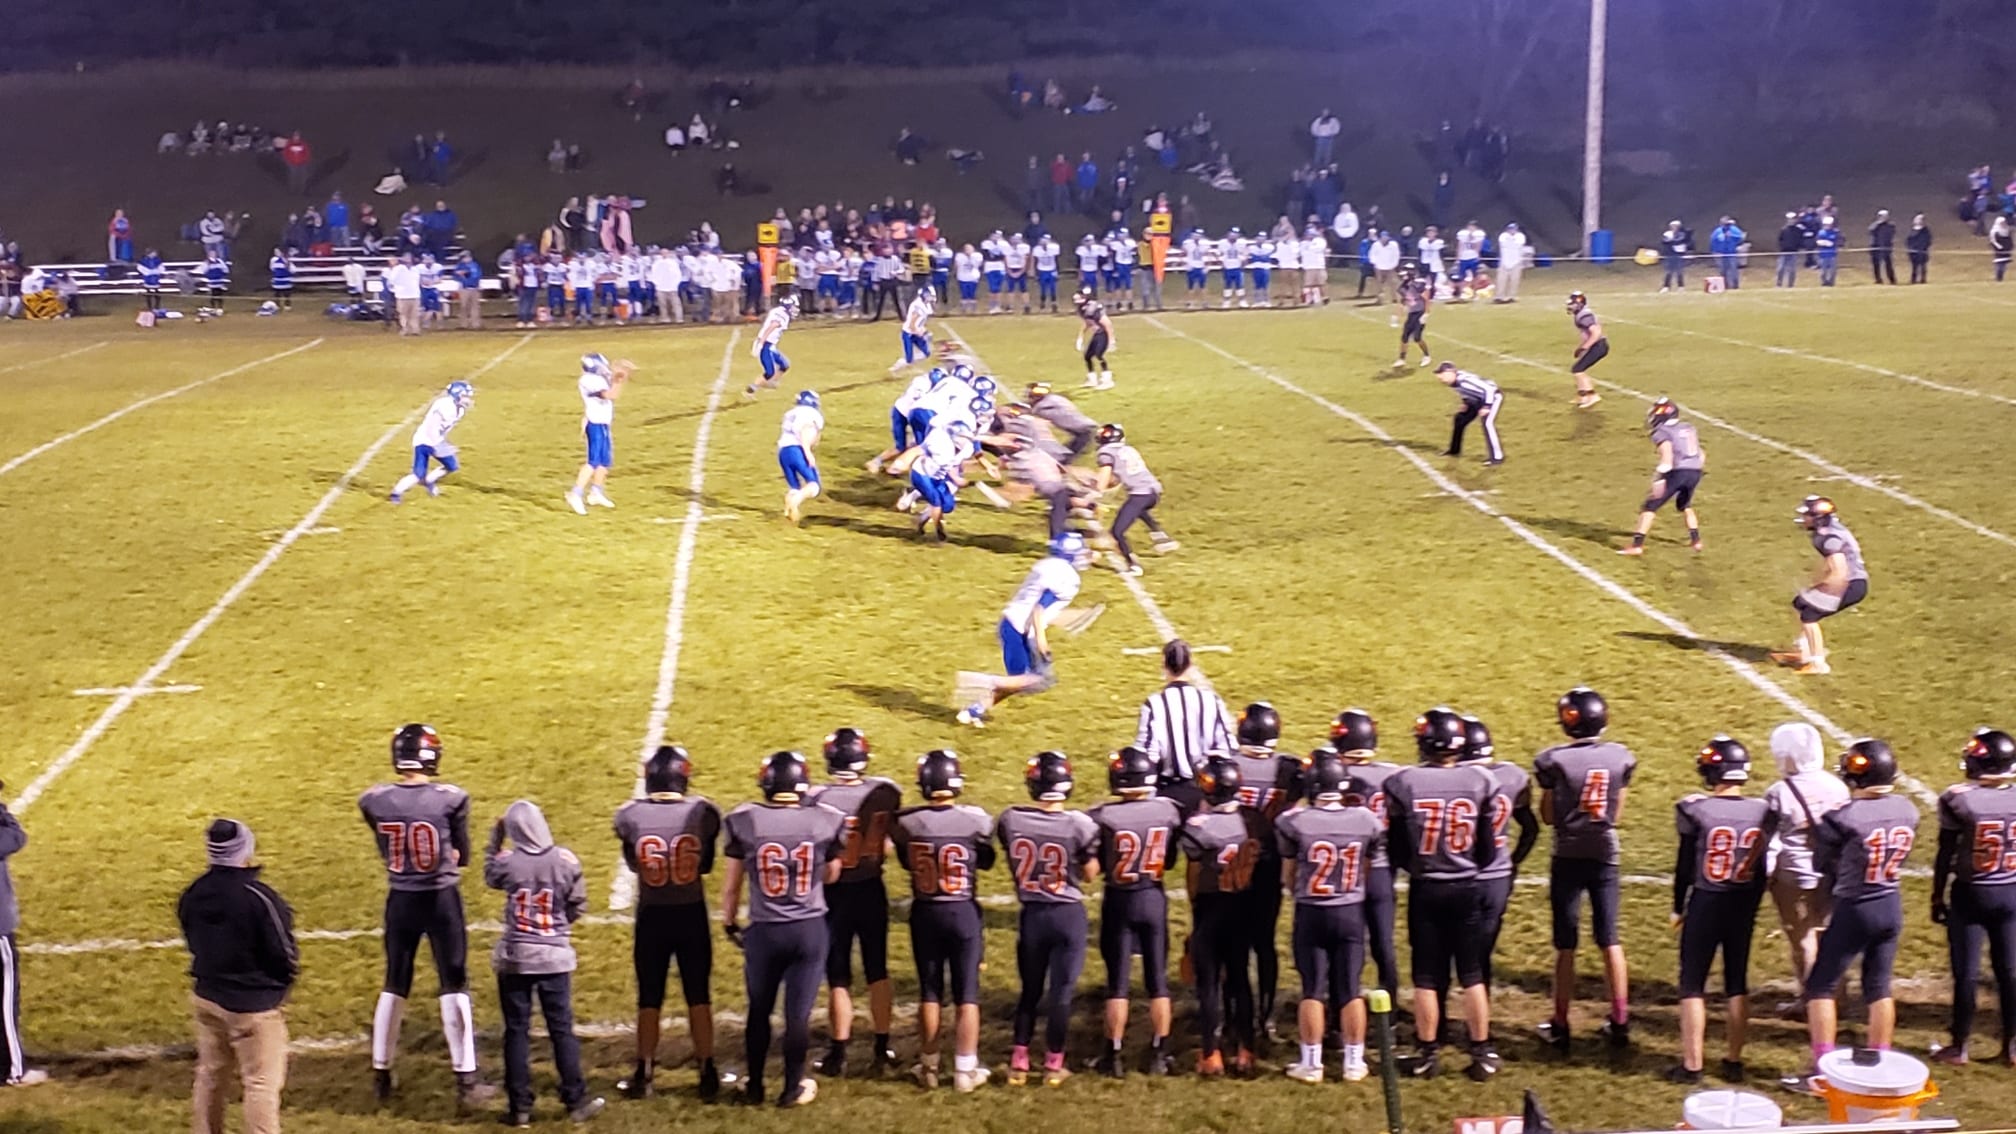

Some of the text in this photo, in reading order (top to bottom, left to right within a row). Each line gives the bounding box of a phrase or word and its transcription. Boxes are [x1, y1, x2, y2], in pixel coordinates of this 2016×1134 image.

[1580, 769, 1609, 822] 4
[377, 821, 440, 873] 70
[1413, 798, 1478, 854] 76
[635, 834, 700, 888] 66
[757, 841, 815, 897] 61
[907, 841, 969, 895] 56
[1013, 838, 1069, 895] 23
[1113, 827, 1169, 885] 24
[1308, 841, 1362, 897] 21
[1863, 826, 1915, 883] 12
[511, 887, 556, 936] 11
